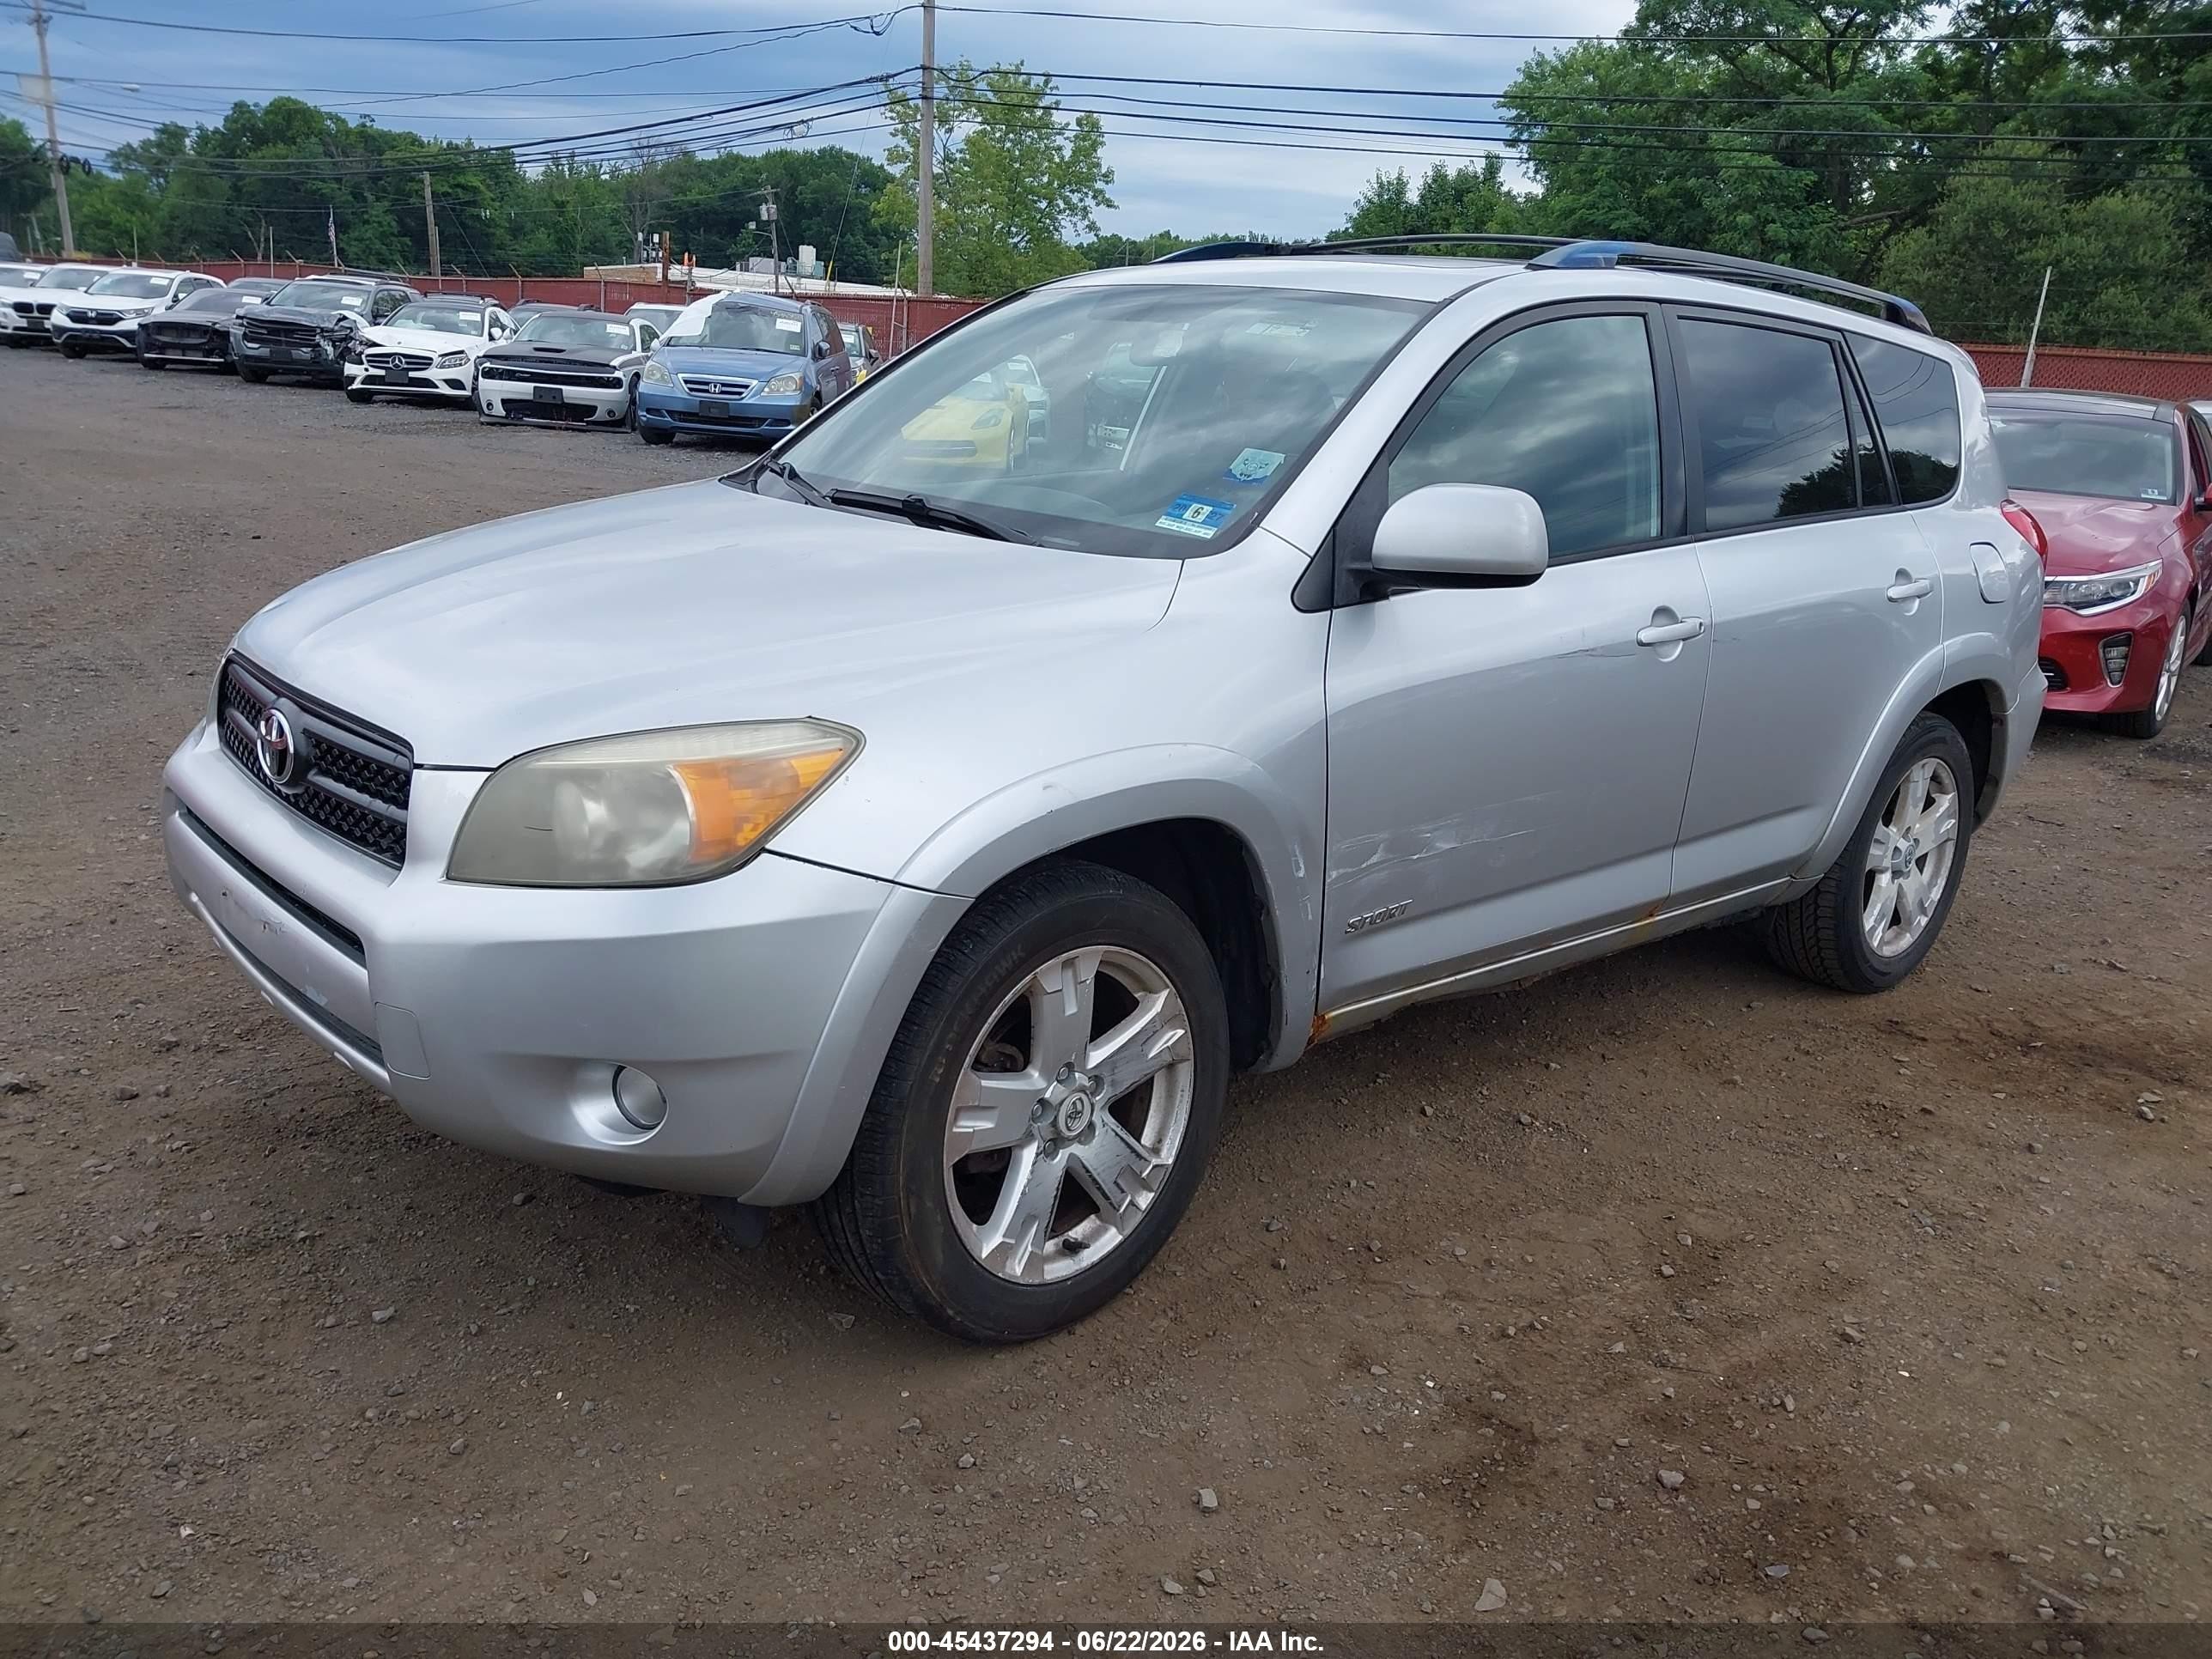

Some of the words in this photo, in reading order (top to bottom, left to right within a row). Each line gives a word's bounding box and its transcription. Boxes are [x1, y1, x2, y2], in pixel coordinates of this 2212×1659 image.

[1191, 507, 1204, 519] 6
[1208, 512, 1223, 521] 27
[1345, 899, 1413, 934] SPORT
